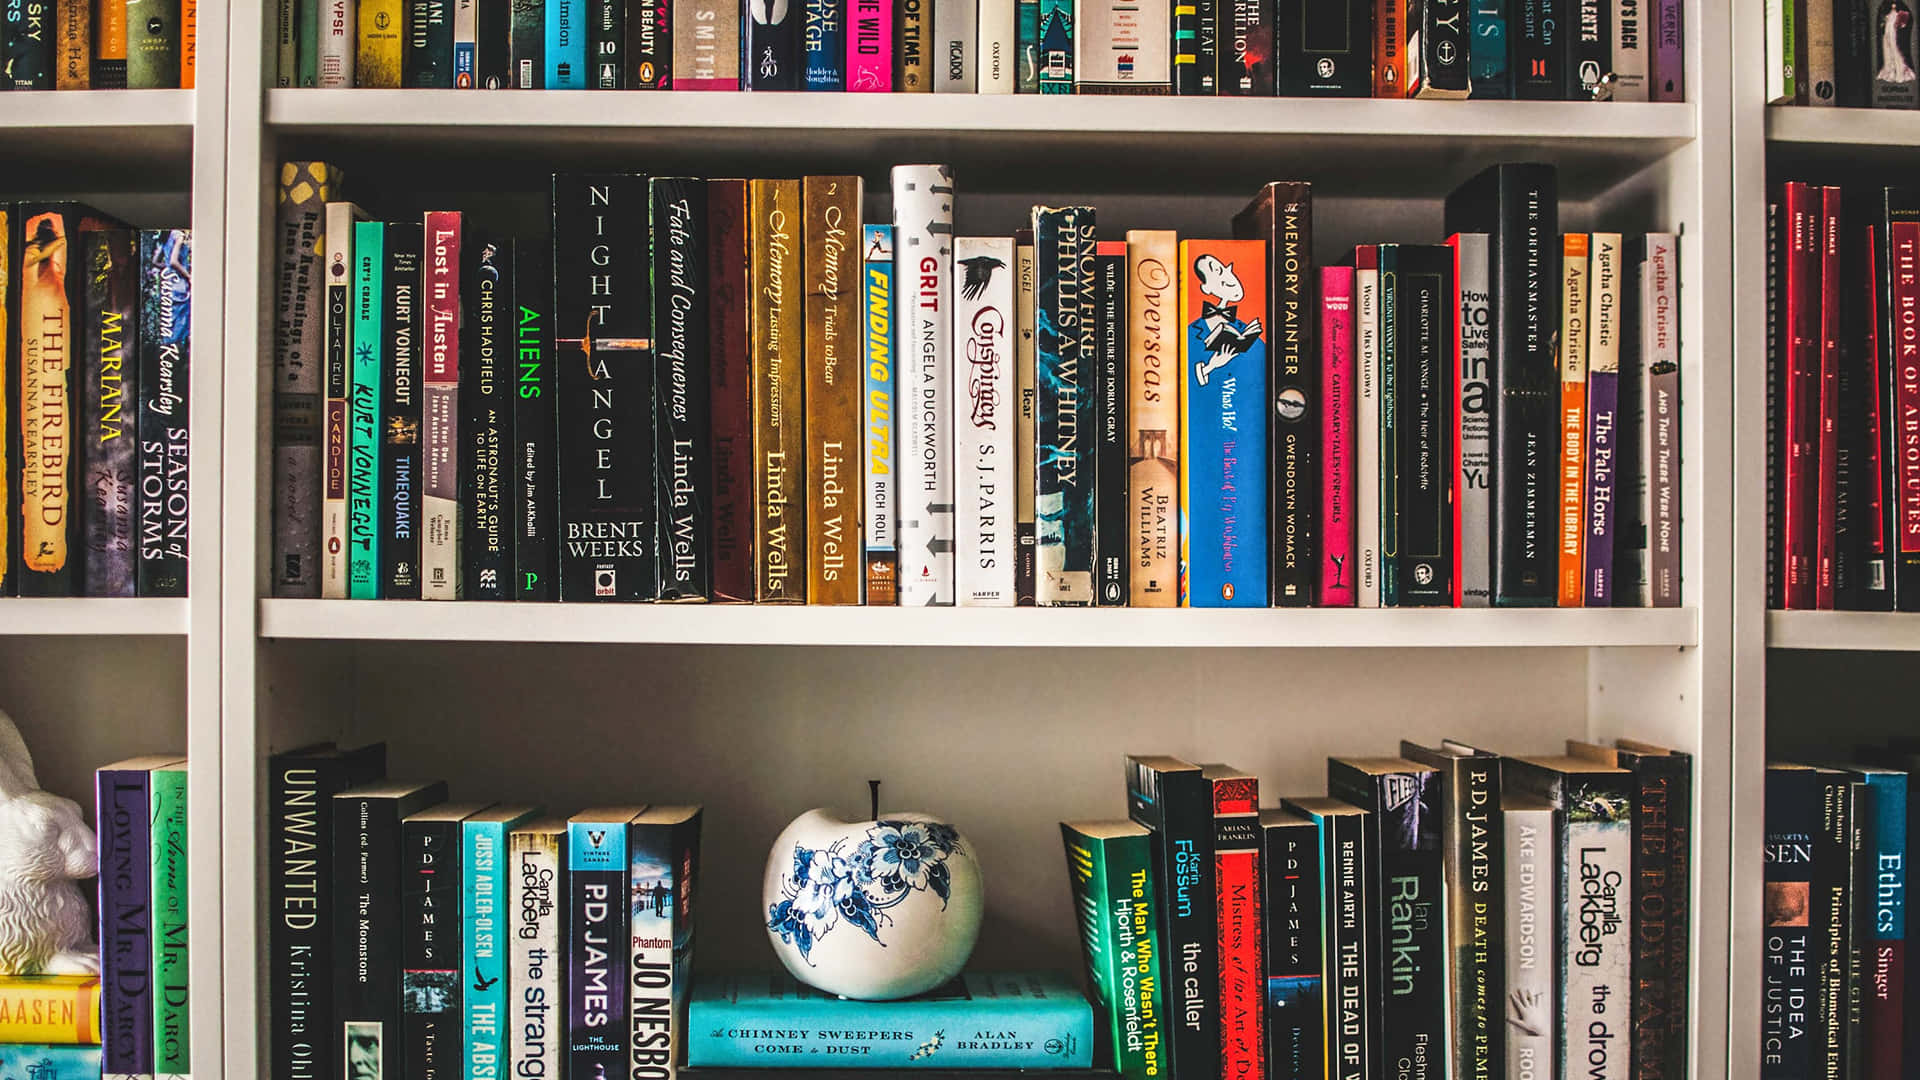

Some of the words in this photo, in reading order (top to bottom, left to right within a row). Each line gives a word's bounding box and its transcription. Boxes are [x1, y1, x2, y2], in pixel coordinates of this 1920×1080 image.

[27, 3, 41, 41] SKY
[603, 5, 612, 31] Smith
[641, 10, 654, 55] BEAUTY
[858, 18, 879, 55] WILD
[600, 41, 615, 54] 10
[696, 11, 715, 79] SMITH
[904, 26, 920, 67] TIME
[950, 41, 963, 80] PICADOR
[669, 200, 690, 246] Fate
[1528, 190, 1538, 220] THE
[434, 230, 454, 275] Lost
[670, 251, 689, 285] and
[1022, 258, 1032, 293] ENGEL
[1057, 225, 1077, 326] PHYLLIS
[1284, 215, 1299, 294] MEMORY
[1597, 242, 1613, 289] Agatha
[1653, 245, 1668, 293] Agatha
[1899, 240, 1913, 286] THE
[160, 267, 178, 337] Susanna
[395, 285, 410, 323] KURT
[434, 283, 451, 299] in
[481, 280, 494, 322] CHRIS
[919, 256, 938, 312] GRIT
[1528, 227, 1538, 353] ORPHANMASTER
[1567, 267, 1581, 315] Agatha
[767, 307, 782, 351] Lasting
[868, 269, 888, 381] FINDING
[1106, 301, 1115, 320] THE
[1137, 258, 1170, 403] Overseas
[1419, 289, 1430, 342] CHARLOTTE
[1599, 293, 1613, 346] Christie
[1656, 296, 1669, 349] Christie
[1901, 297, 1916, 356] BOOK
[42, 309, 63, 374] THE
[332, 292, 344, 386] VOLTAIRE
[430, 306, 453, 374] Austen
[481, 326, 494, 395] HADFIELD
[519, 306, 541, 399] ALIENS
[661, 293, 693, 421] Consequences
[922, 320, 936, 383] ANGELA
[1057, 332, 1075, 356] A.
[1106, 322, 1115, 360] PICTURE
[1284, 300, 1299, 375] PAINTER
[1568, 319, 1581, 371] Christie
[26, 338, 39, 412] SUSANNA
[100, 310, 122, 442] MARIANA
[149, 343, 181, 415] Kearsley
[395, 326, 410, 405] VONNEGUT
[1106, 362, 1115, 375] OF
[1420, 359, 1430, 391] YONGE
[1904, 367, 1917, 396] OF
[353, 384, 372, 438] KURT
[768, 358, 784, 428] Impressions
[1022, 388, 1033, 419] Bear
[1106, 377, 1115, 414] DORIAN
[1420, 401, 1429, 418] The
[870, 389, 889, 475] ULTRA
[923, 389, 937, 491] DUCKWORTH
[1056, 363, 1078, 487] WHITNEY
[1106, 417, 1115, 443] GRAY
[1420, 420, 1430, 438] Heir
[1567, 407, 1580, 430] THE
[1595, 411, 1612, 444] The
[26, 418, 39, 498] KEARSLEY
[42, 383, 63, 526] FIREBIRD
[331, 410, 341, 490] CANDIDE
[476, 449, 486, 471] LIFE
[526, 443, 535, 468] Edited
[1527, 432, 1536, 465] JEAN
[1566, 432, 1579, 463] BODY
[1594, 449, 1612, 482] Pale
[166, 428, 188, 538] SEASON
[524, 470, 534, 481] by
[674, 440, 693, 508] Linda
[766, 450, 786, 518] Linda
[822, 440, 842, 508] Linda
[874, 482, 885, 509] RICH
[1285, 434, 1296, 510] GWENDOLYN
[1565, 481, 1578, 504] THE
[1566, 466, 1578, 478] IN
[142, 440, 163, 560] STORMS
[394, 457, 410, 539] TIMEQUAKE
[476, 492, 487, 529] EARTH
[1526, 472, 1536, 559] ZIMMERMAN
[1593, 487, 1610, 536] Horse
[488, 513, 498, 552] GUIDE
[568, 522, 643, 538] BRENT
[568, 541, 644, 557] WEEKS
[675, 515, 694, 581] Wells
[823, 515, 843, 581] Wells
[875, 514, 886, 542] ROLL
[1140, 487, 1154, 568] WILLIAMS
[1156, 495, 1169, 559] BEATRIZ
[1285, 514, 1296, 568] WOMACK
[1564, 506, 1578, 555] LIBRARY
[768, 525, 787, 590] Wells
[1364, 549, 1373, 588] OXFORD
[112, 780, 144, 890] LOVING
[360, 802, 368, 829] Collins
[283, 769, 317, 930] UNWANTED
[475, 834, 493, 871] JUSSI
[1342, 841, 1354, 886] RENNIE
[1467, 812, 1488, 893] JAMES
[1520, 826, 1537, 857] ÅKE
[539, 868, 554, 917] Camilla
[1131, 869, 1145, 897] The
[1175, 840, 1193, 917] Fossum
[1190, 853, 1200, 885] Karin
[1877, 852, 1901, 933] Ethics
[359, 894, 369, 916] The
[475, 875, 493, 958] ADLER-OLSEN
[1113, 898, 1136, 947] Hjorth
[1134, 903, 1148, 935] Man
[1231, 884, 1247, 949] Mistress
[1343, 891, 1355, 928] AIRTH
[1415, 902, 1432, 930] Ian
[1519, 864, 1535, 969] EDWARDSON
[1576, 847, 1606, 967] Lackberg
[1603, 870, 1622, 935] Camilla
[1828, 887, 1843, 955] Principles
[359, 919, 370, 982] Moonstone
[632, 936, 672, 949] Phantom
[1120, 950, 1135, 963] &
[1136, 939, 1151, 973] Who
[1391, 875, 1421, 996] Rankin
[1474, 903, 1487, 963] DEATH
[1767, 936, 1783, 965] OF
[1790, 936, 1805, 976] THE
[584, 931, 607, 1027] JAMES
[632, 953, 671, 988] JO
[1183, 943, 1201, 973] the
[1342, 942, 1358, 978] THE
[1829, 959, 1841, 973] of
[1874, 947, 1893, 1000] Singer
[289, 945, 312, 1034] Kristina
[1122, 967, 1142, 1052] Rosenfeldt
[1139, 976, 1155, 1029] Wasn't
[1184, 977, 1203, 1031] caller
[1343, 986, 1358, 1035] DEAD
[1592, 984, 1611, 1014] the
[1789, 988, 1804, 1039] IDEA
[1828, 977, 1841, 1048] Biomedical
[163, 985, 188, 1066] DARCY
[472, 1003, 495, 1035] THE
[728, 1029, 809, 1040] CHIMNEY
[818, 1029, 913, 1040] SWEEPERS
[974, 1031, 1017, 1039] ALAN
[1234, 1008, 1247, 1033] Art
[1766, 976, 1782, 1065] JUSTICE
[754, 1044, 803, 1054] COME
[826, 1044, 871, 1054] DUST
[957, 1041, 1034, 1050] BRADLEY
[1144, 1031, 1159, 1076] There
[1345, 1043, 1358, 1065] OF
